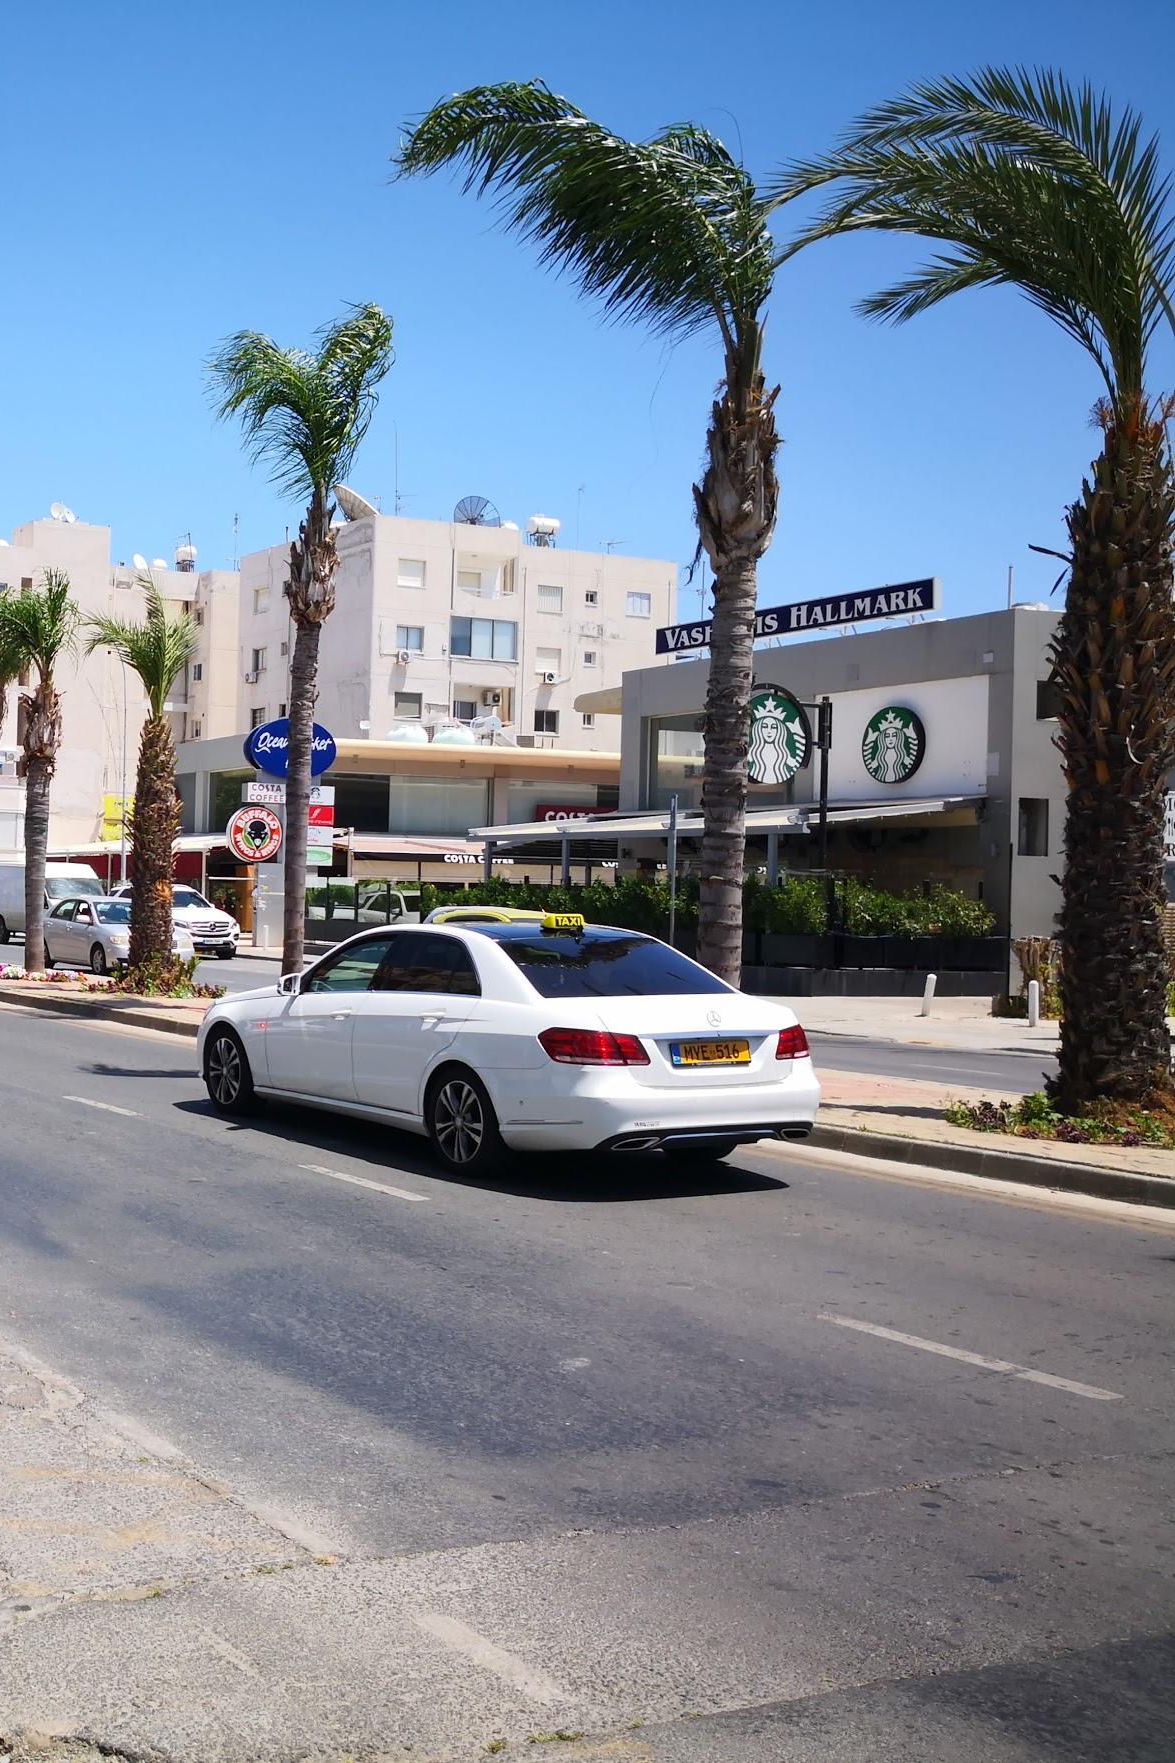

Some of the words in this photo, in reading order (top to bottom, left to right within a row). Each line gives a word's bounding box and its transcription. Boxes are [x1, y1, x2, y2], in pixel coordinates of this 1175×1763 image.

[790, 587, 924, 628] HALLMARK
[252, 784, 281, 792] COSTA
[250, 794, 284, 802] COFFEE
[236, 810, 279, 828] BUFFALO
[235, 833, 255, 857] WINGS
[444, 855, 476, 864] COSTA
[556, 916, 581, 926] TAXI
[715, 1044, 739, 1059] 516
